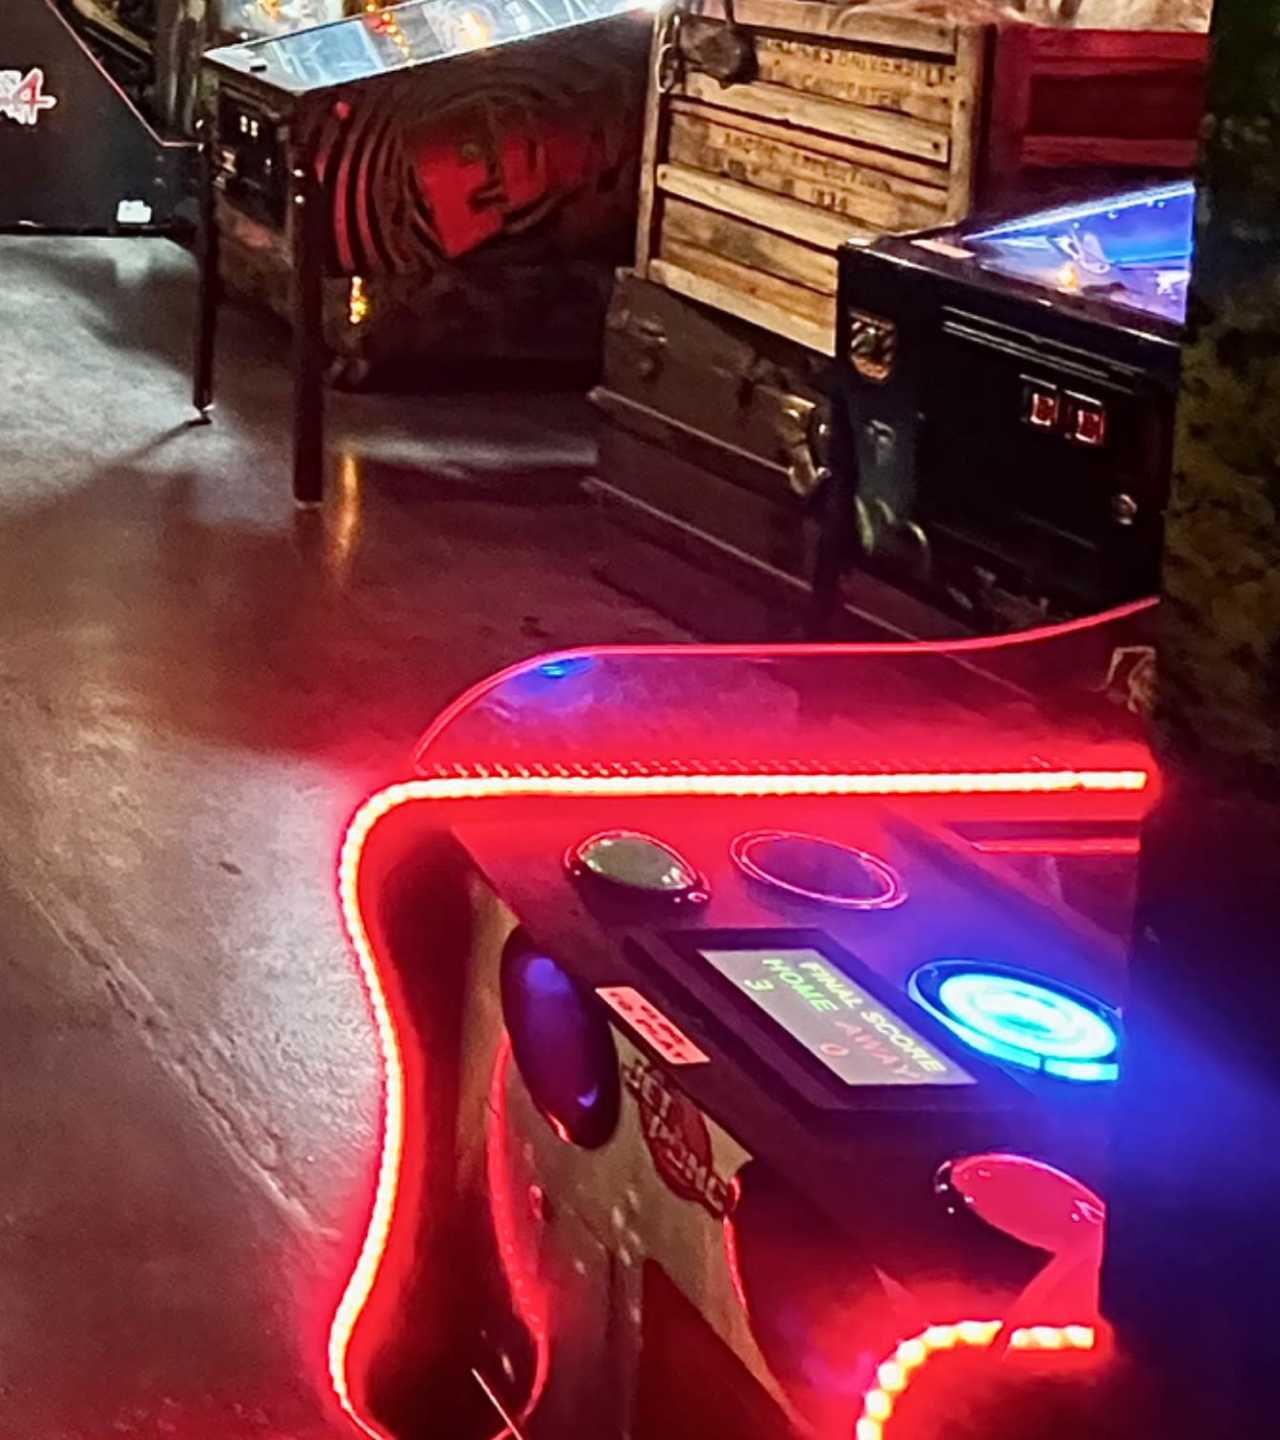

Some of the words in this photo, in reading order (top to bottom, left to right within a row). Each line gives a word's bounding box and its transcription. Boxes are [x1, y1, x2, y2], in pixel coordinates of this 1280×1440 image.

[743, 978, 775, 992] 3
[819, 1042, 849, 1057] 0
[762, 957, 839, 1013] HOME
[834, 1019, 921, 1079] AWAY
[799, 960, 864, 1010] FINAL
[860, 1010, 947, 1073] SCORE
